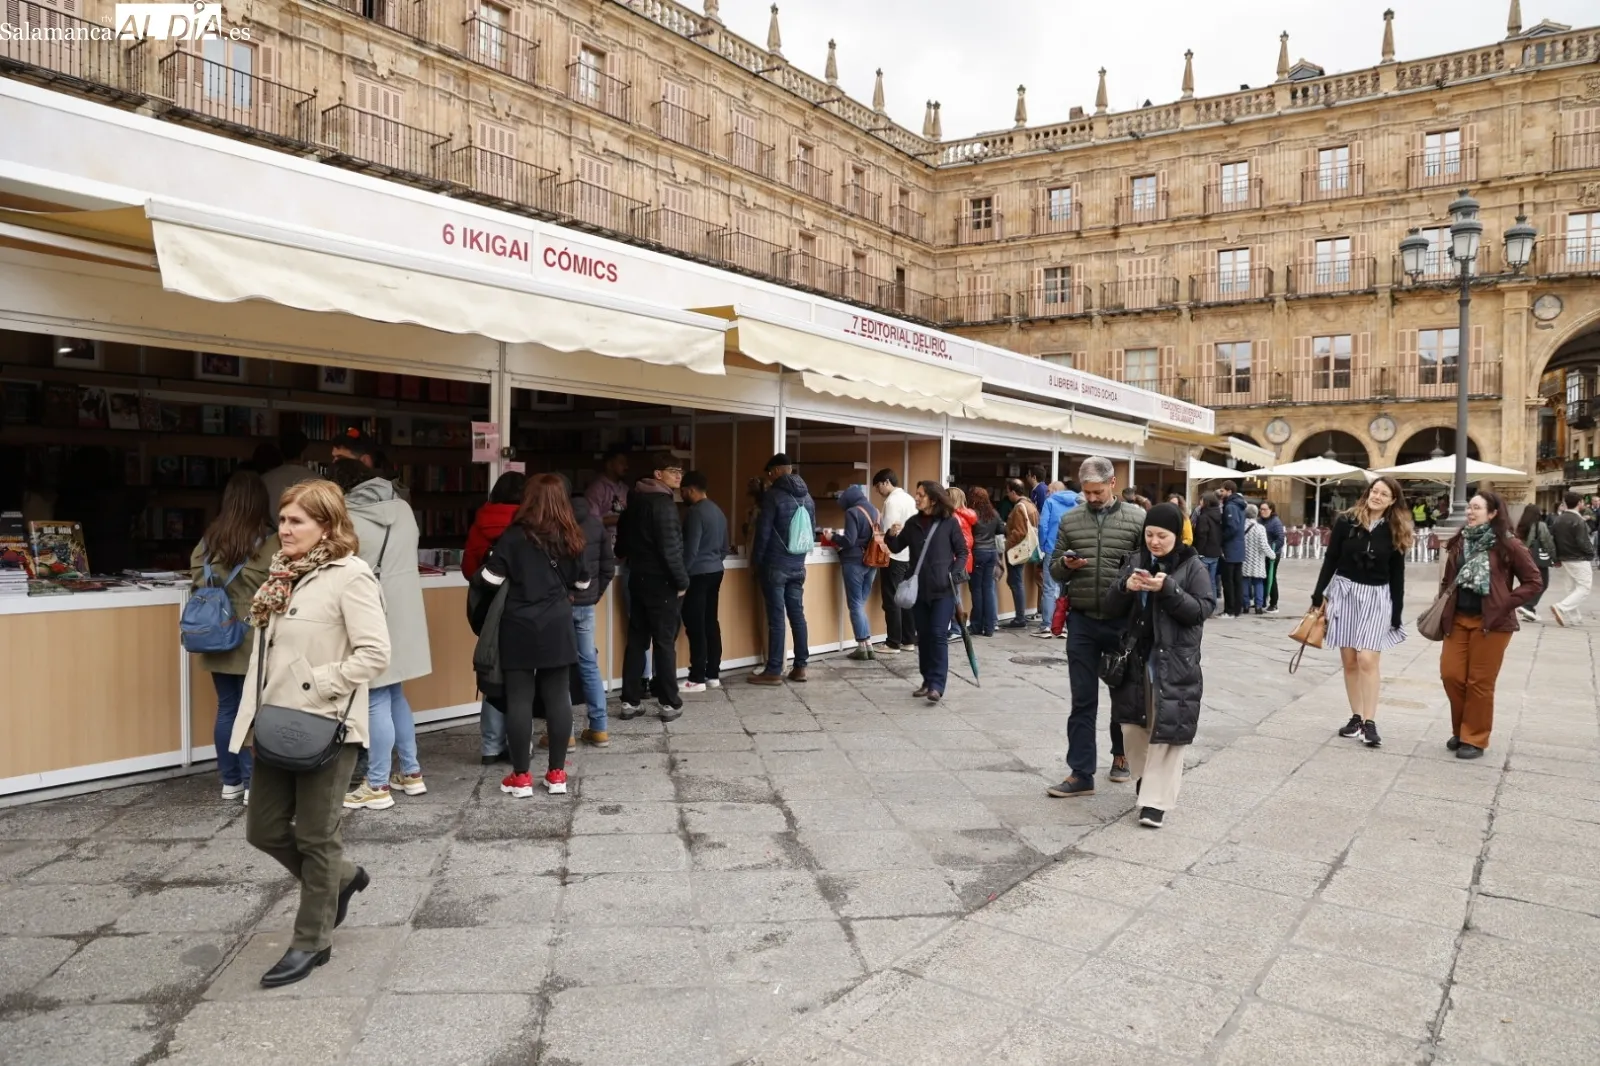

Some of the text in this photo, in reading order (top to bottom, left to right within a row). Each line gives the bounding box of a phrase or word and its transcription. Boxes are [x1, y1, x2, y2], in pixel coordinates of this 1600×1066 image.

[442, 223, 618, 282] 6 IKIGAI CÓMICS
[852, 315, 859, 329] 7
[861, 318, 911, 344] EDITORIAL
[913, 332, 946, 353] DELIRIO
[1081, 383, 1100, 398] SANTOS
